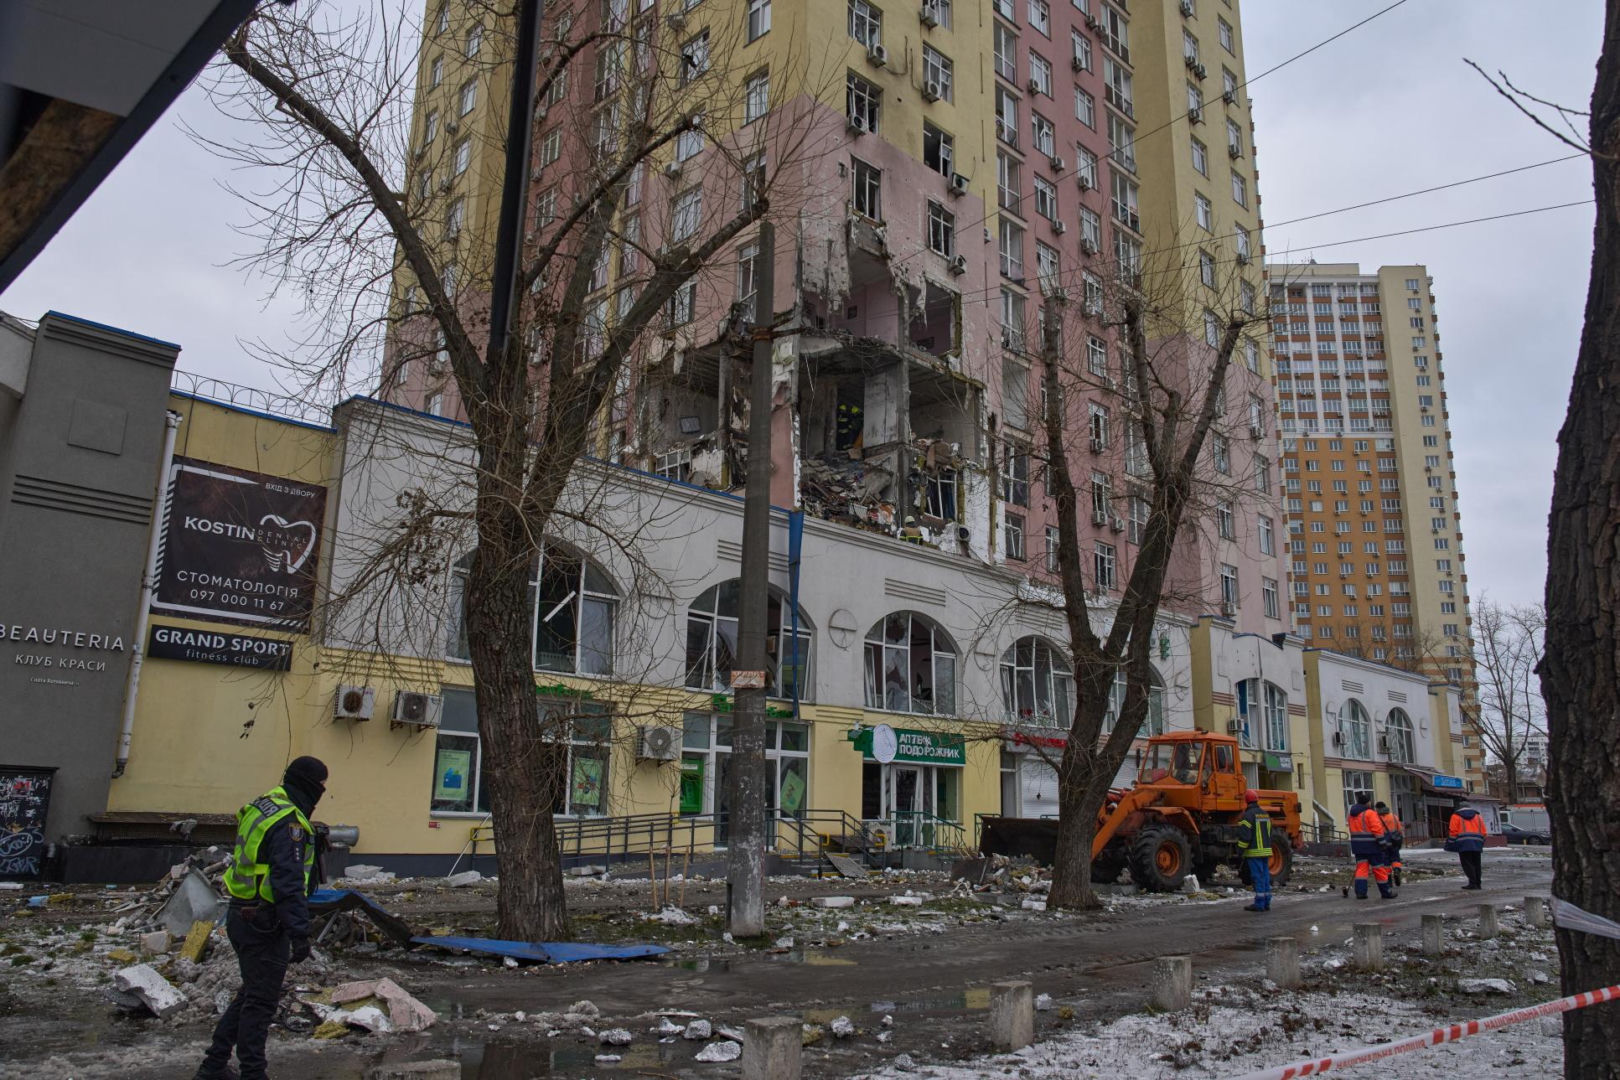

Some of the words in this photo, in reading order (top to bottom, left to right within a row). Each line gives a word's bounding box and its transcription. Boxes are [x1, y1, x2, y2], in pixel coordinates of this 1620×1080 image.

[265, 482, 282, 493] ВХІД
[290, 488, 316, 499] ДВОРУ
[184, 516, 256, 541] KOSTIN
[176, 570, 299, 599] СТОМАТОЛОГІЯ
[190, 589, 215, 601] 097
[221, 593, 248, 606] 000
[254, 598, 264, 609] 11
[269, 601, 285, 611] 67
[155, 629, 226, 649] GRAND
[231, 638, 290, 657] SPORT
[15, 653, 53, 667] КЛУБ
[59, 657, 106, 672] КРАСИ
[186, 648, 228, 662] fitness
[234, 655, 259, 666] club
[899, 744, 960, 759] ПОДОРОЖНИК
